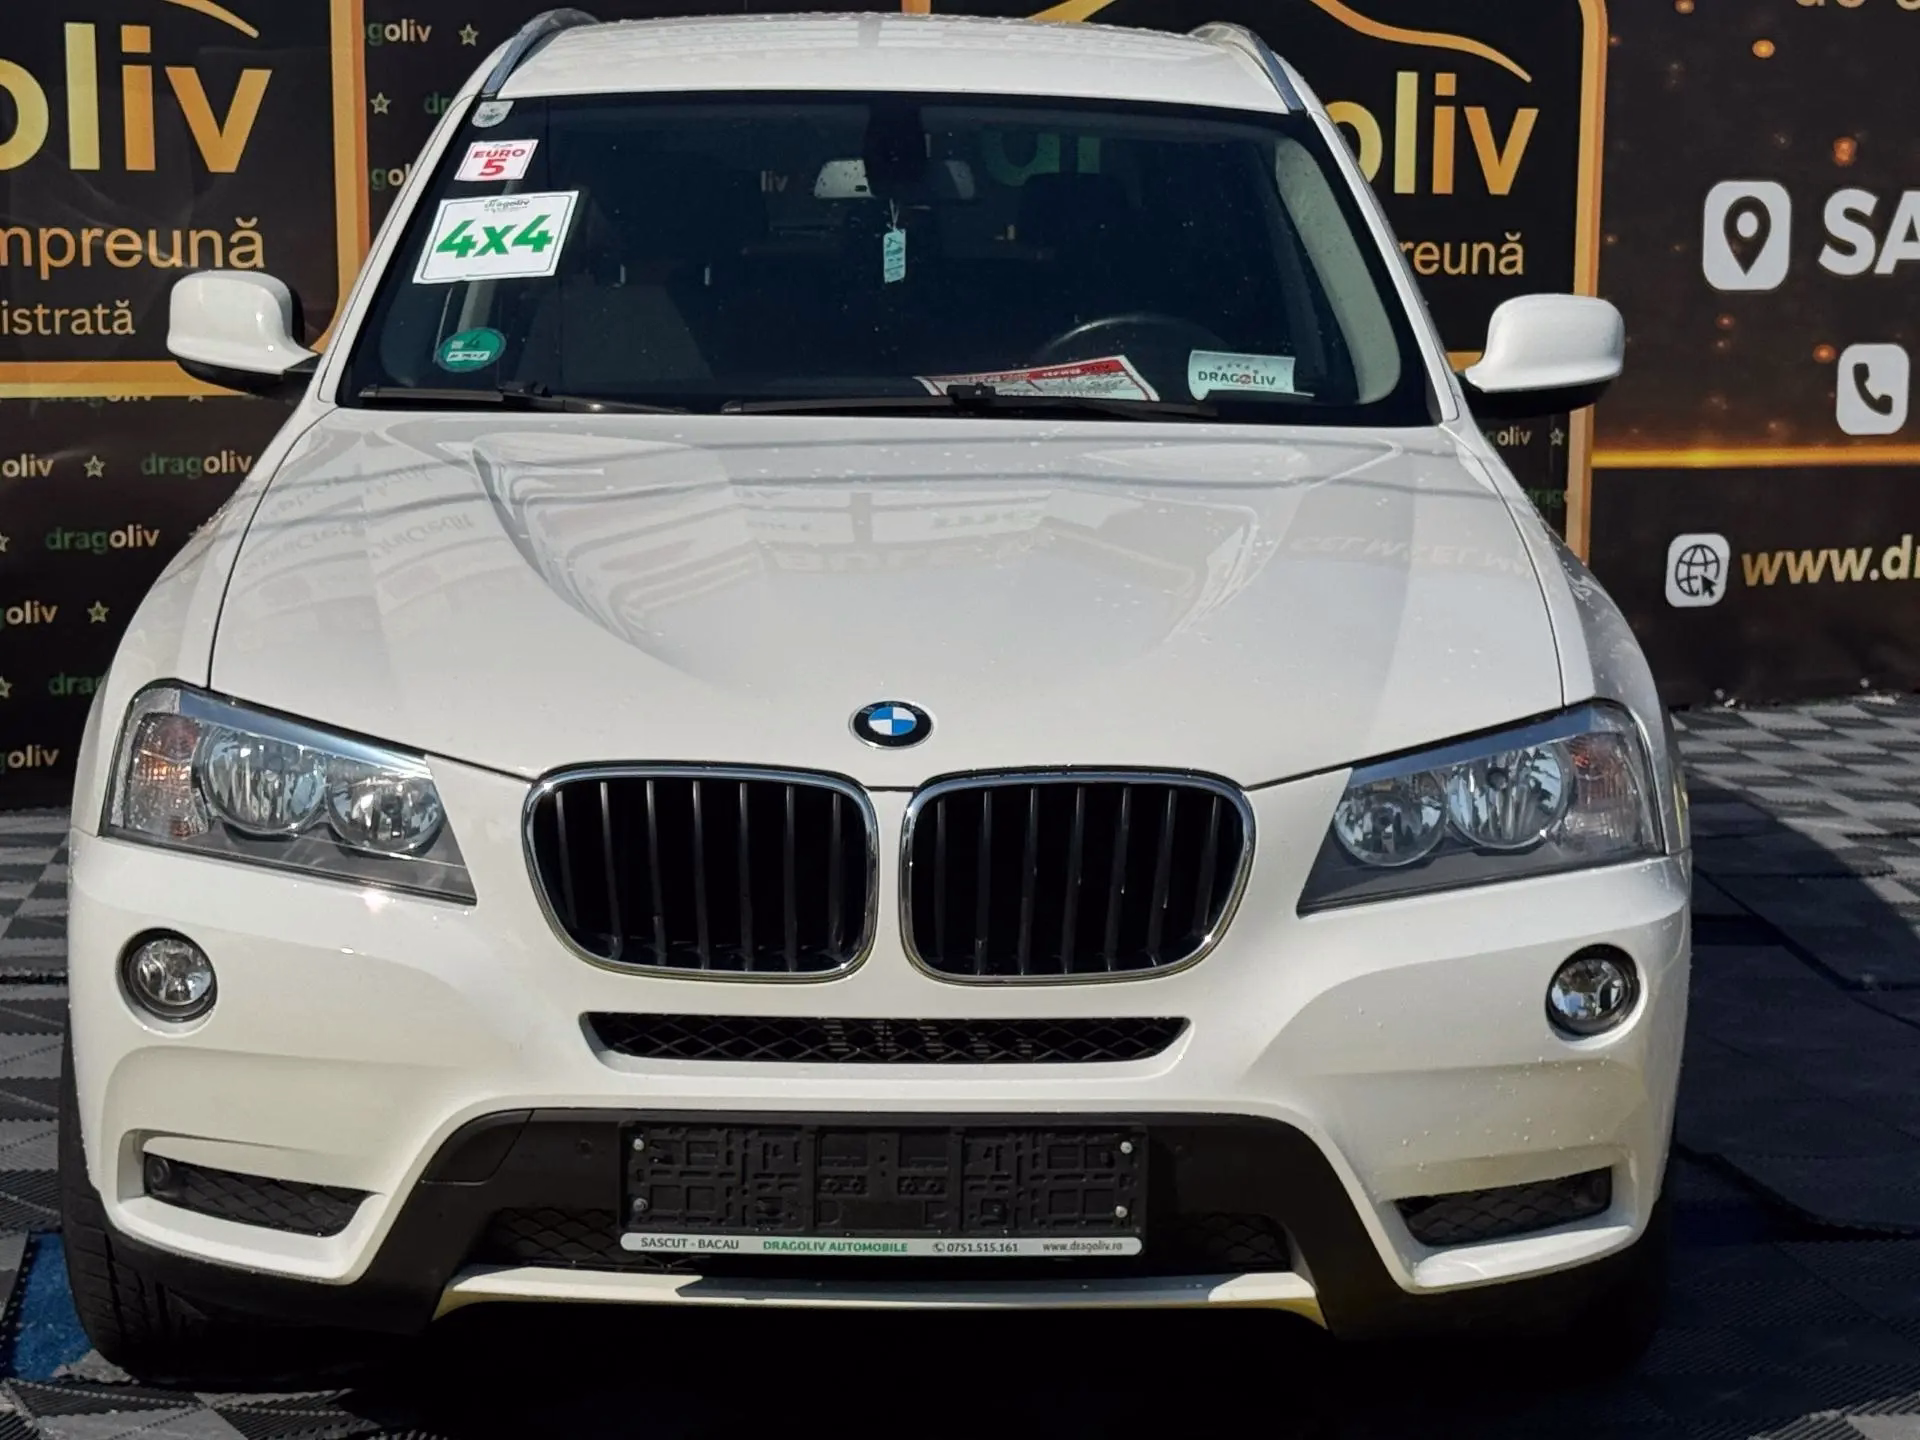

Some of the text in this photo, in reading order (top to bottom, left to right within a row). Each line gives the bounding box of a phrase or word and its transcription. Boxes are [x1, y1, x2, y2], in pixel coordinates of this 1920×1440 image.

[367, 18, 432, 46] goliv
[473, 149, 526, 159] EURO
[478, 159, 508, 176] 5
[435, 214, 555, 259] 4x4
[1818, 188, 1920, 276] SA
[1198, 371, 1276, 386] DRAGOLIV
[141, 450, 252, 479] dragoliv
[46, 524, 160, 555] dragoliv
[641, 1237, 688, 1249] SASCUT
[698, 1239, 740, 1250] BACAU
[763, 1240, 826, 1251] DRAGOLIV
[829, 1241, 908, 1252] AUTOMOBILE
[946, 1242, 1019, 1253] 0751.515.161
